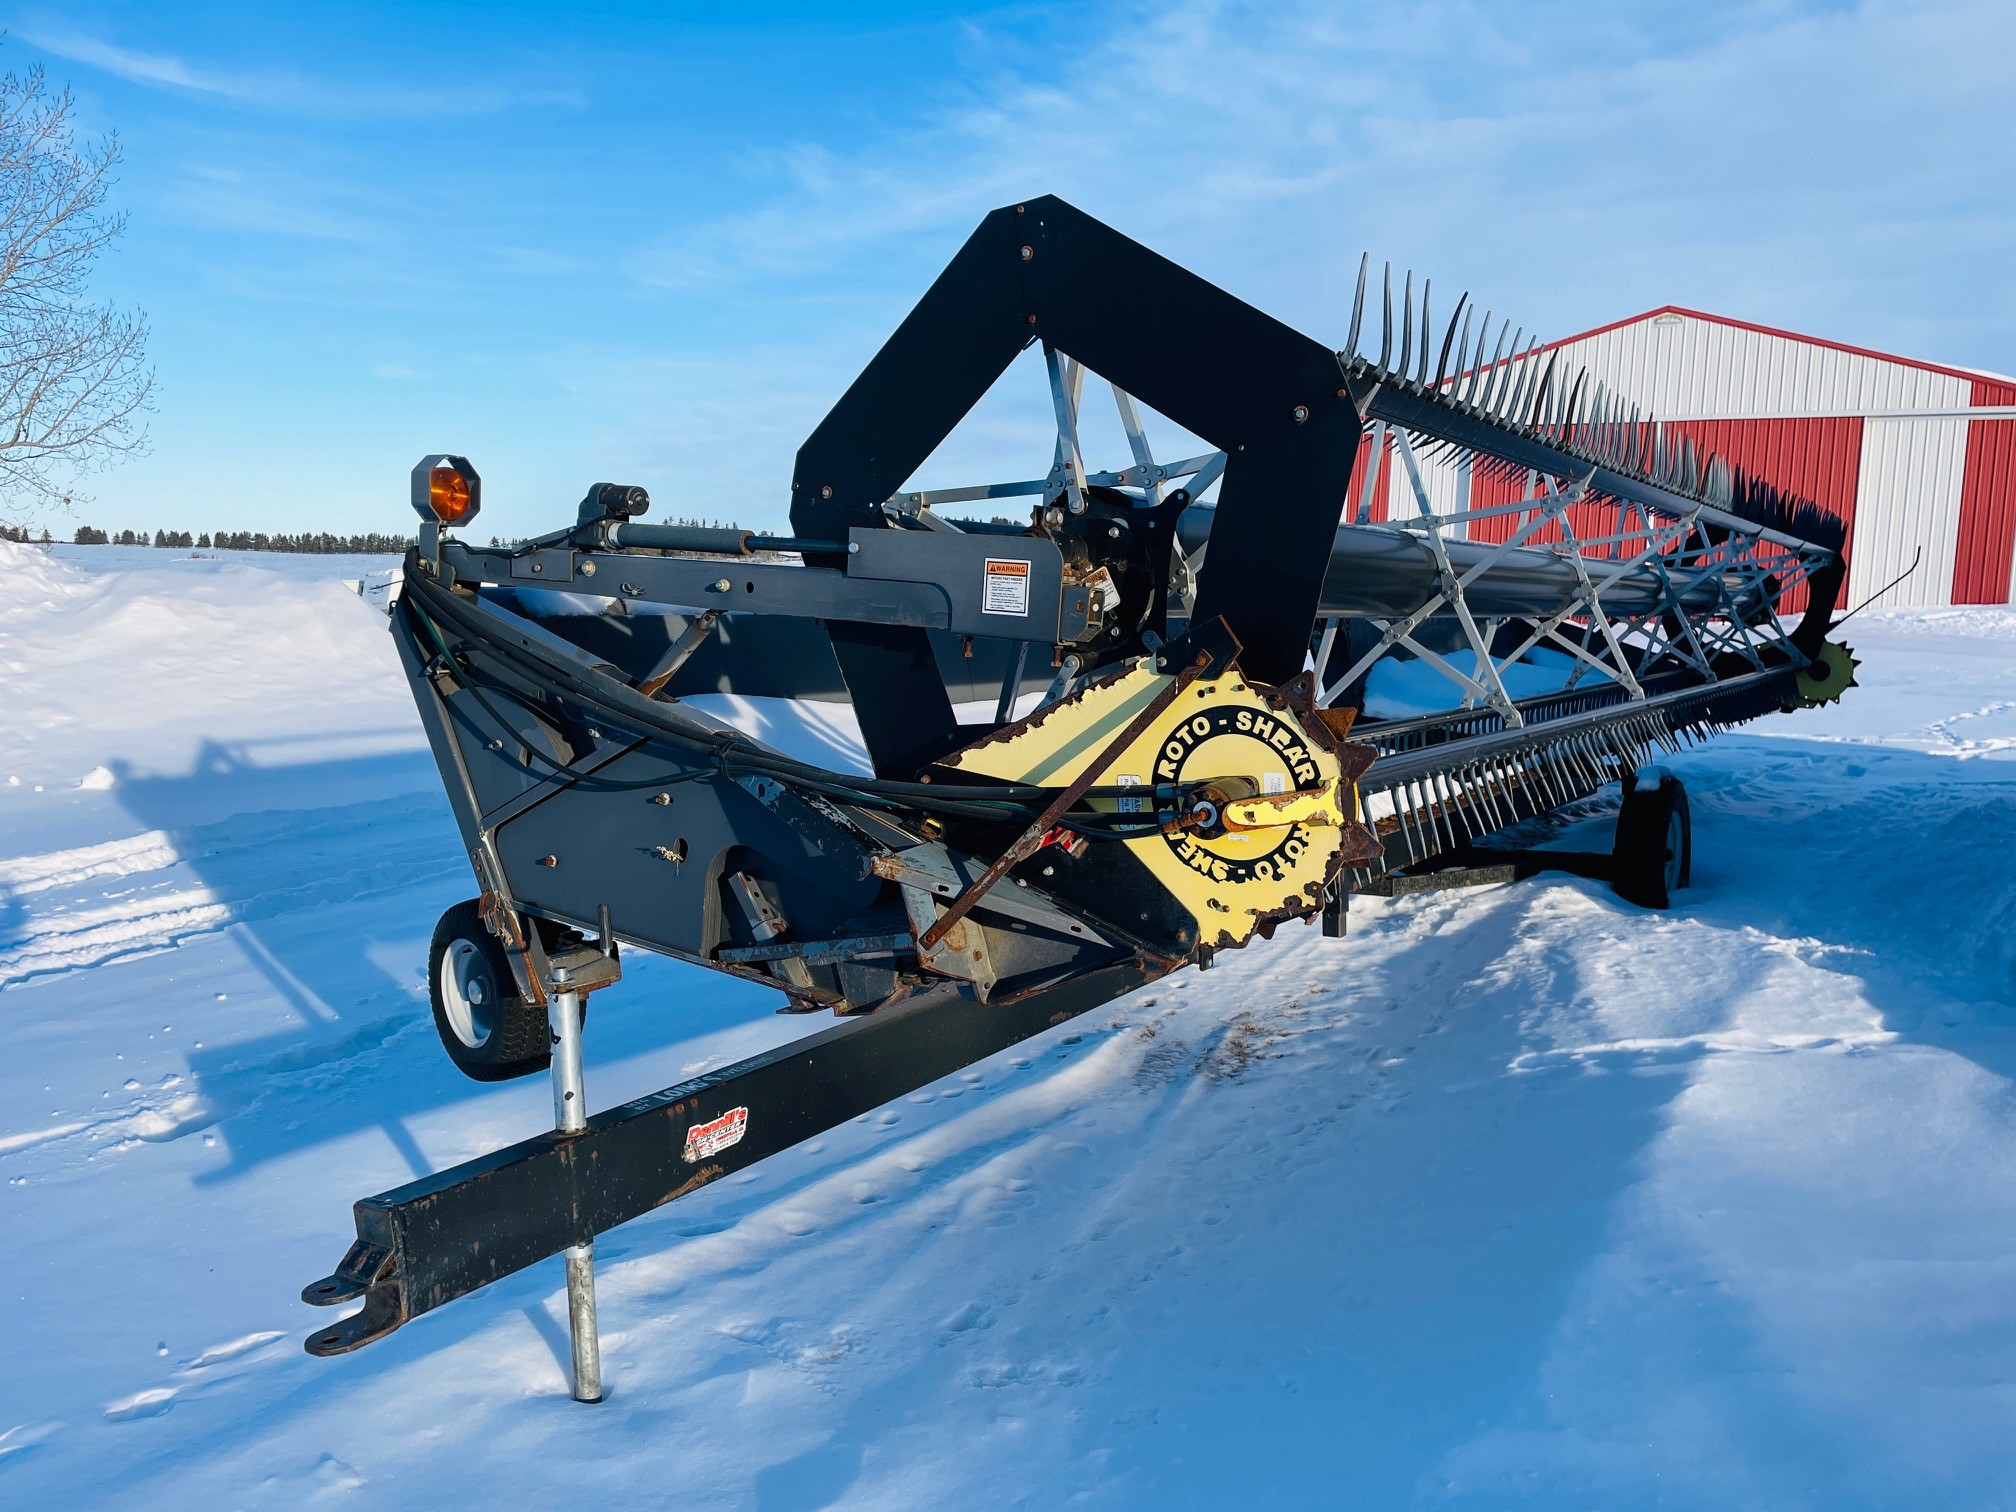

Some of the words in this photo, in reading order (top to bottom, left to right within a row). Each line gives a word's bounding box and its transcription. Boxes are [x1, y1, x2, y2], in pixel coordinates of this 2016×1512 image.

[1158, 717, 1210, 780] ROTO
[1236, 712, 1315, 784] SHEAR
[653, 1075, 722, 1101] LONG'S
